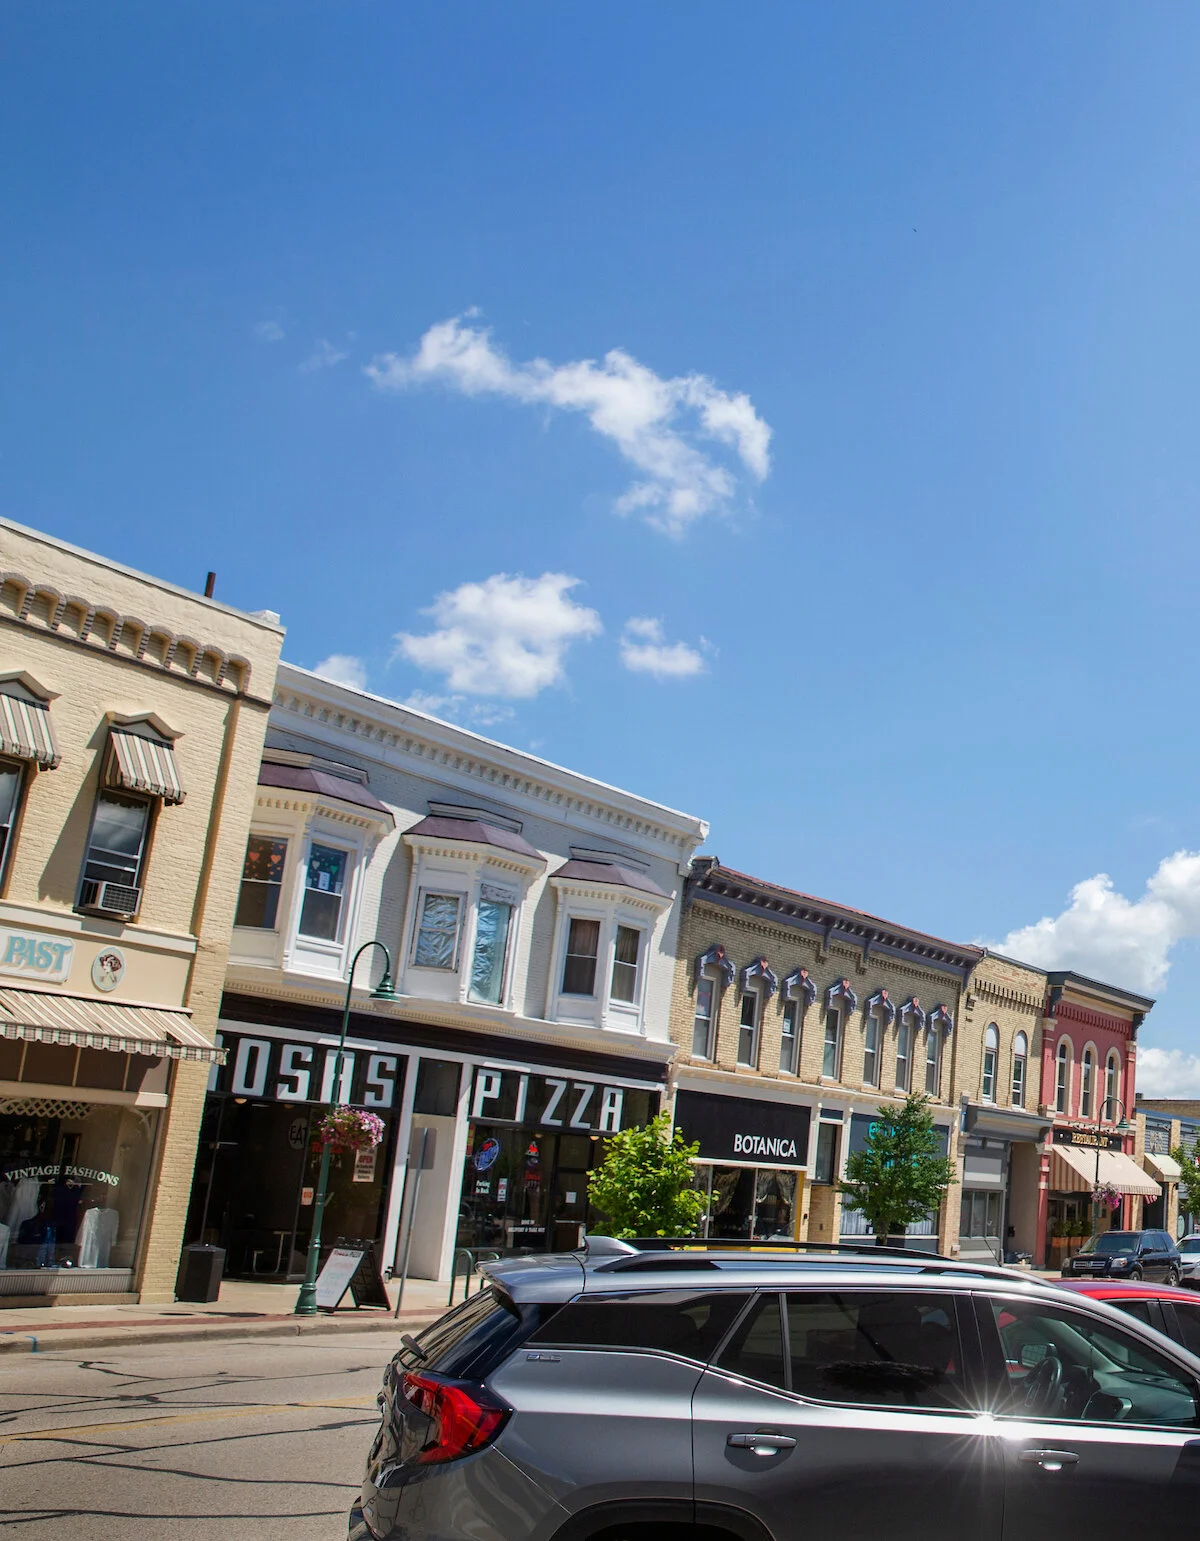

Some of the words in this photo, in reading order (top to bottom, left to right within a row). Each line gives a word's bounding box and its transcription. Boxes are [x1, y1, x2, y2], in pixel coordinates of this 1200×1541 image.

[3, 935, 73, 972] PAST
[472, 1068, 624, 1132] PIZZA
[733, 1133, 798, 1158] BOTANICA
[1071, 1132, 1108, 1147] RESTAURNT
[4, 1165, 60, 1181] VINTAGE
[64, 1165, 120, 1186] FASHIONS
